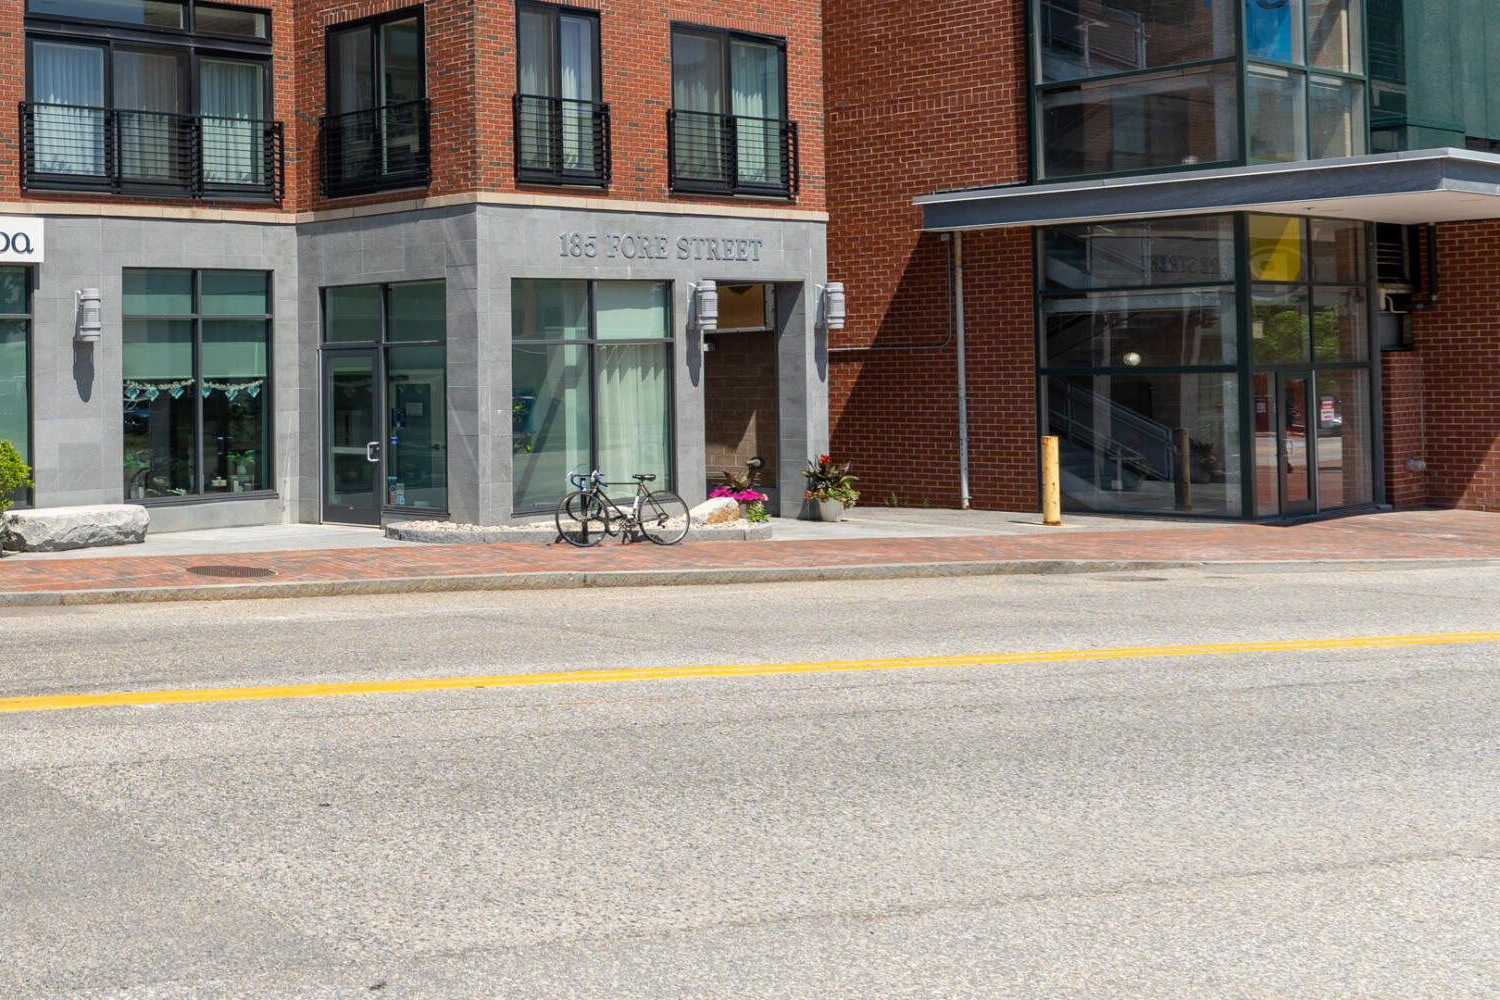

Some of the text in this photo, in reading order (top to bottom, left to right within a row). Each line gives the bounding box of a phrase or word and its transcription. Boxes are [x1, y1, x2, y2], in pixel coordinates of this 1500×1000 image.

[558, 231, 763, 262] 185 FORE STREET
